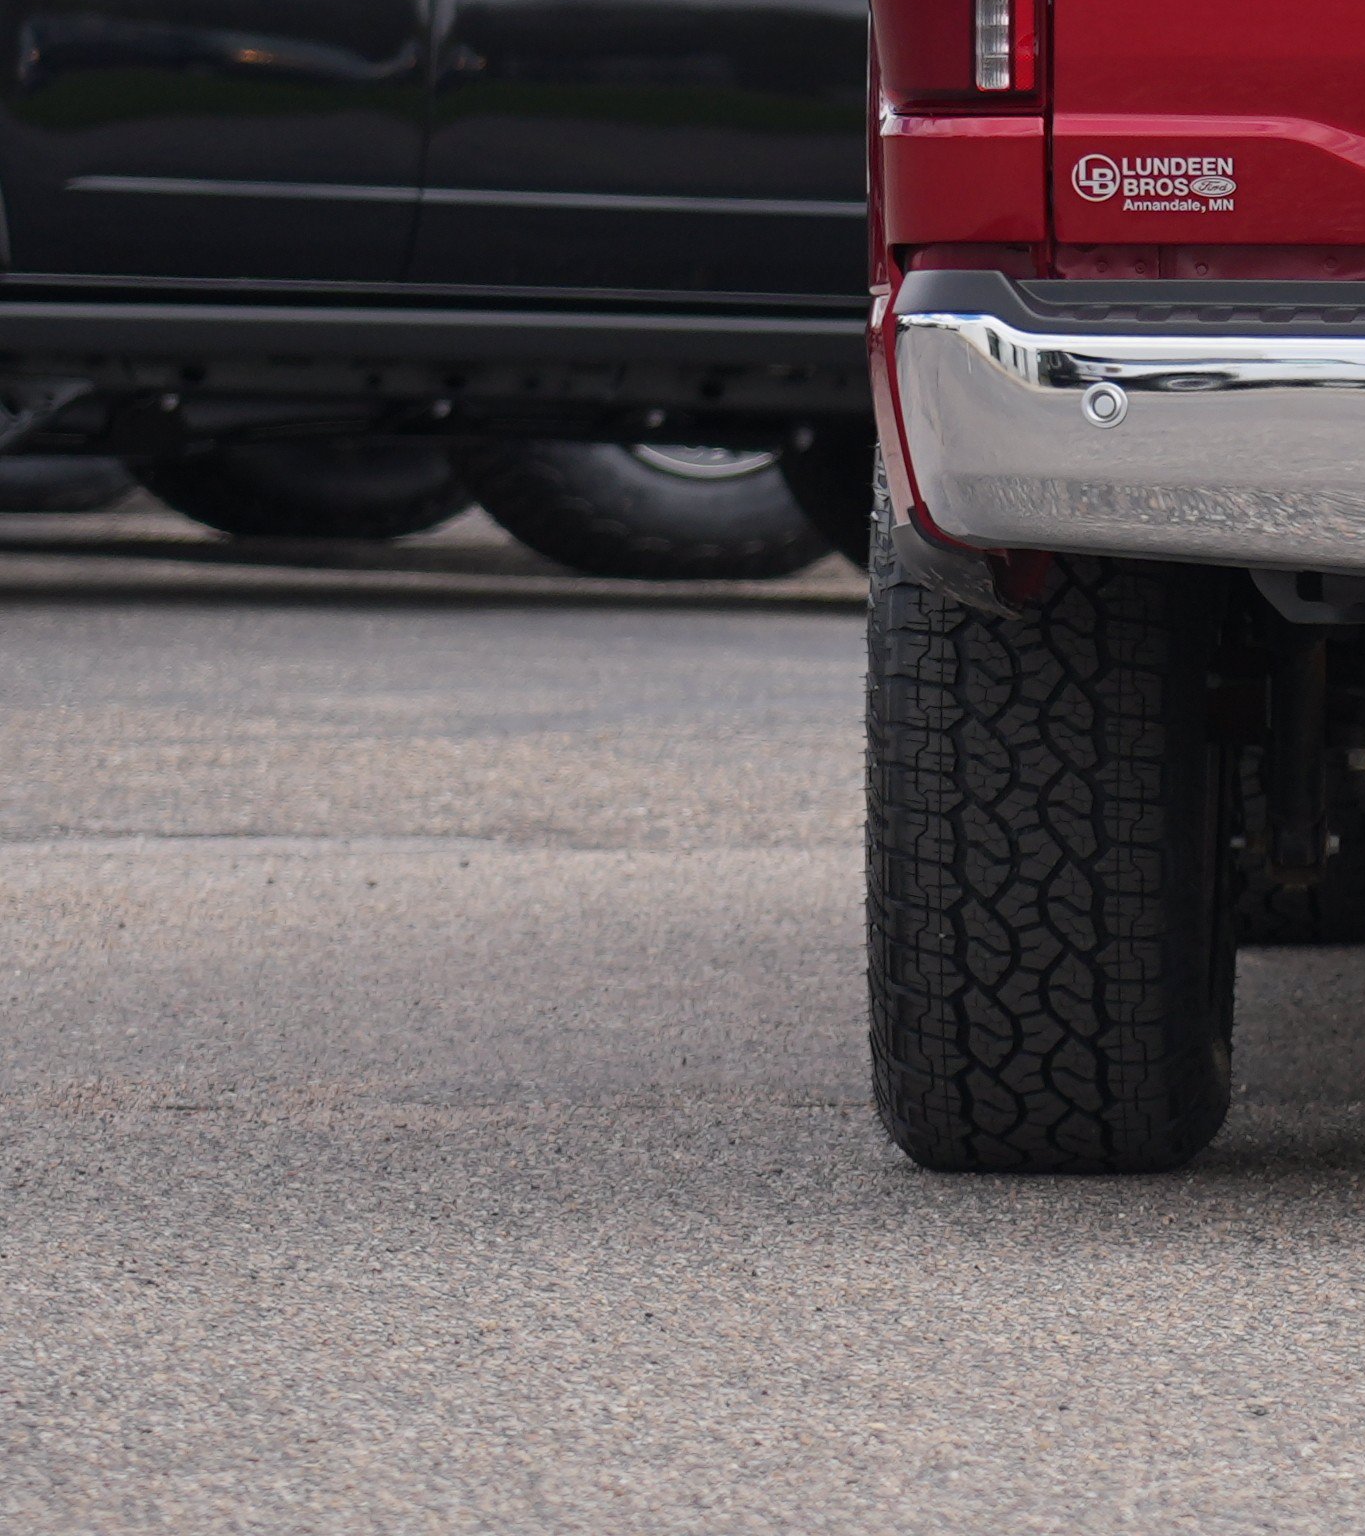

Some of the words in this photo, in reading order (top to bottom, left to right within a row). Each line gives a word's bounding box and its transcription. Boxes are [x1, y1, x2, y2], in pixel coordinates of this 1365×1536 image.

[1121, 157, 1234, 175] LUNDEEN
[1122, 178, 1190, 196] BROS
[1122, 198, 1207, 214] Annandale,
[1208, 198, 1234, 212] MN
